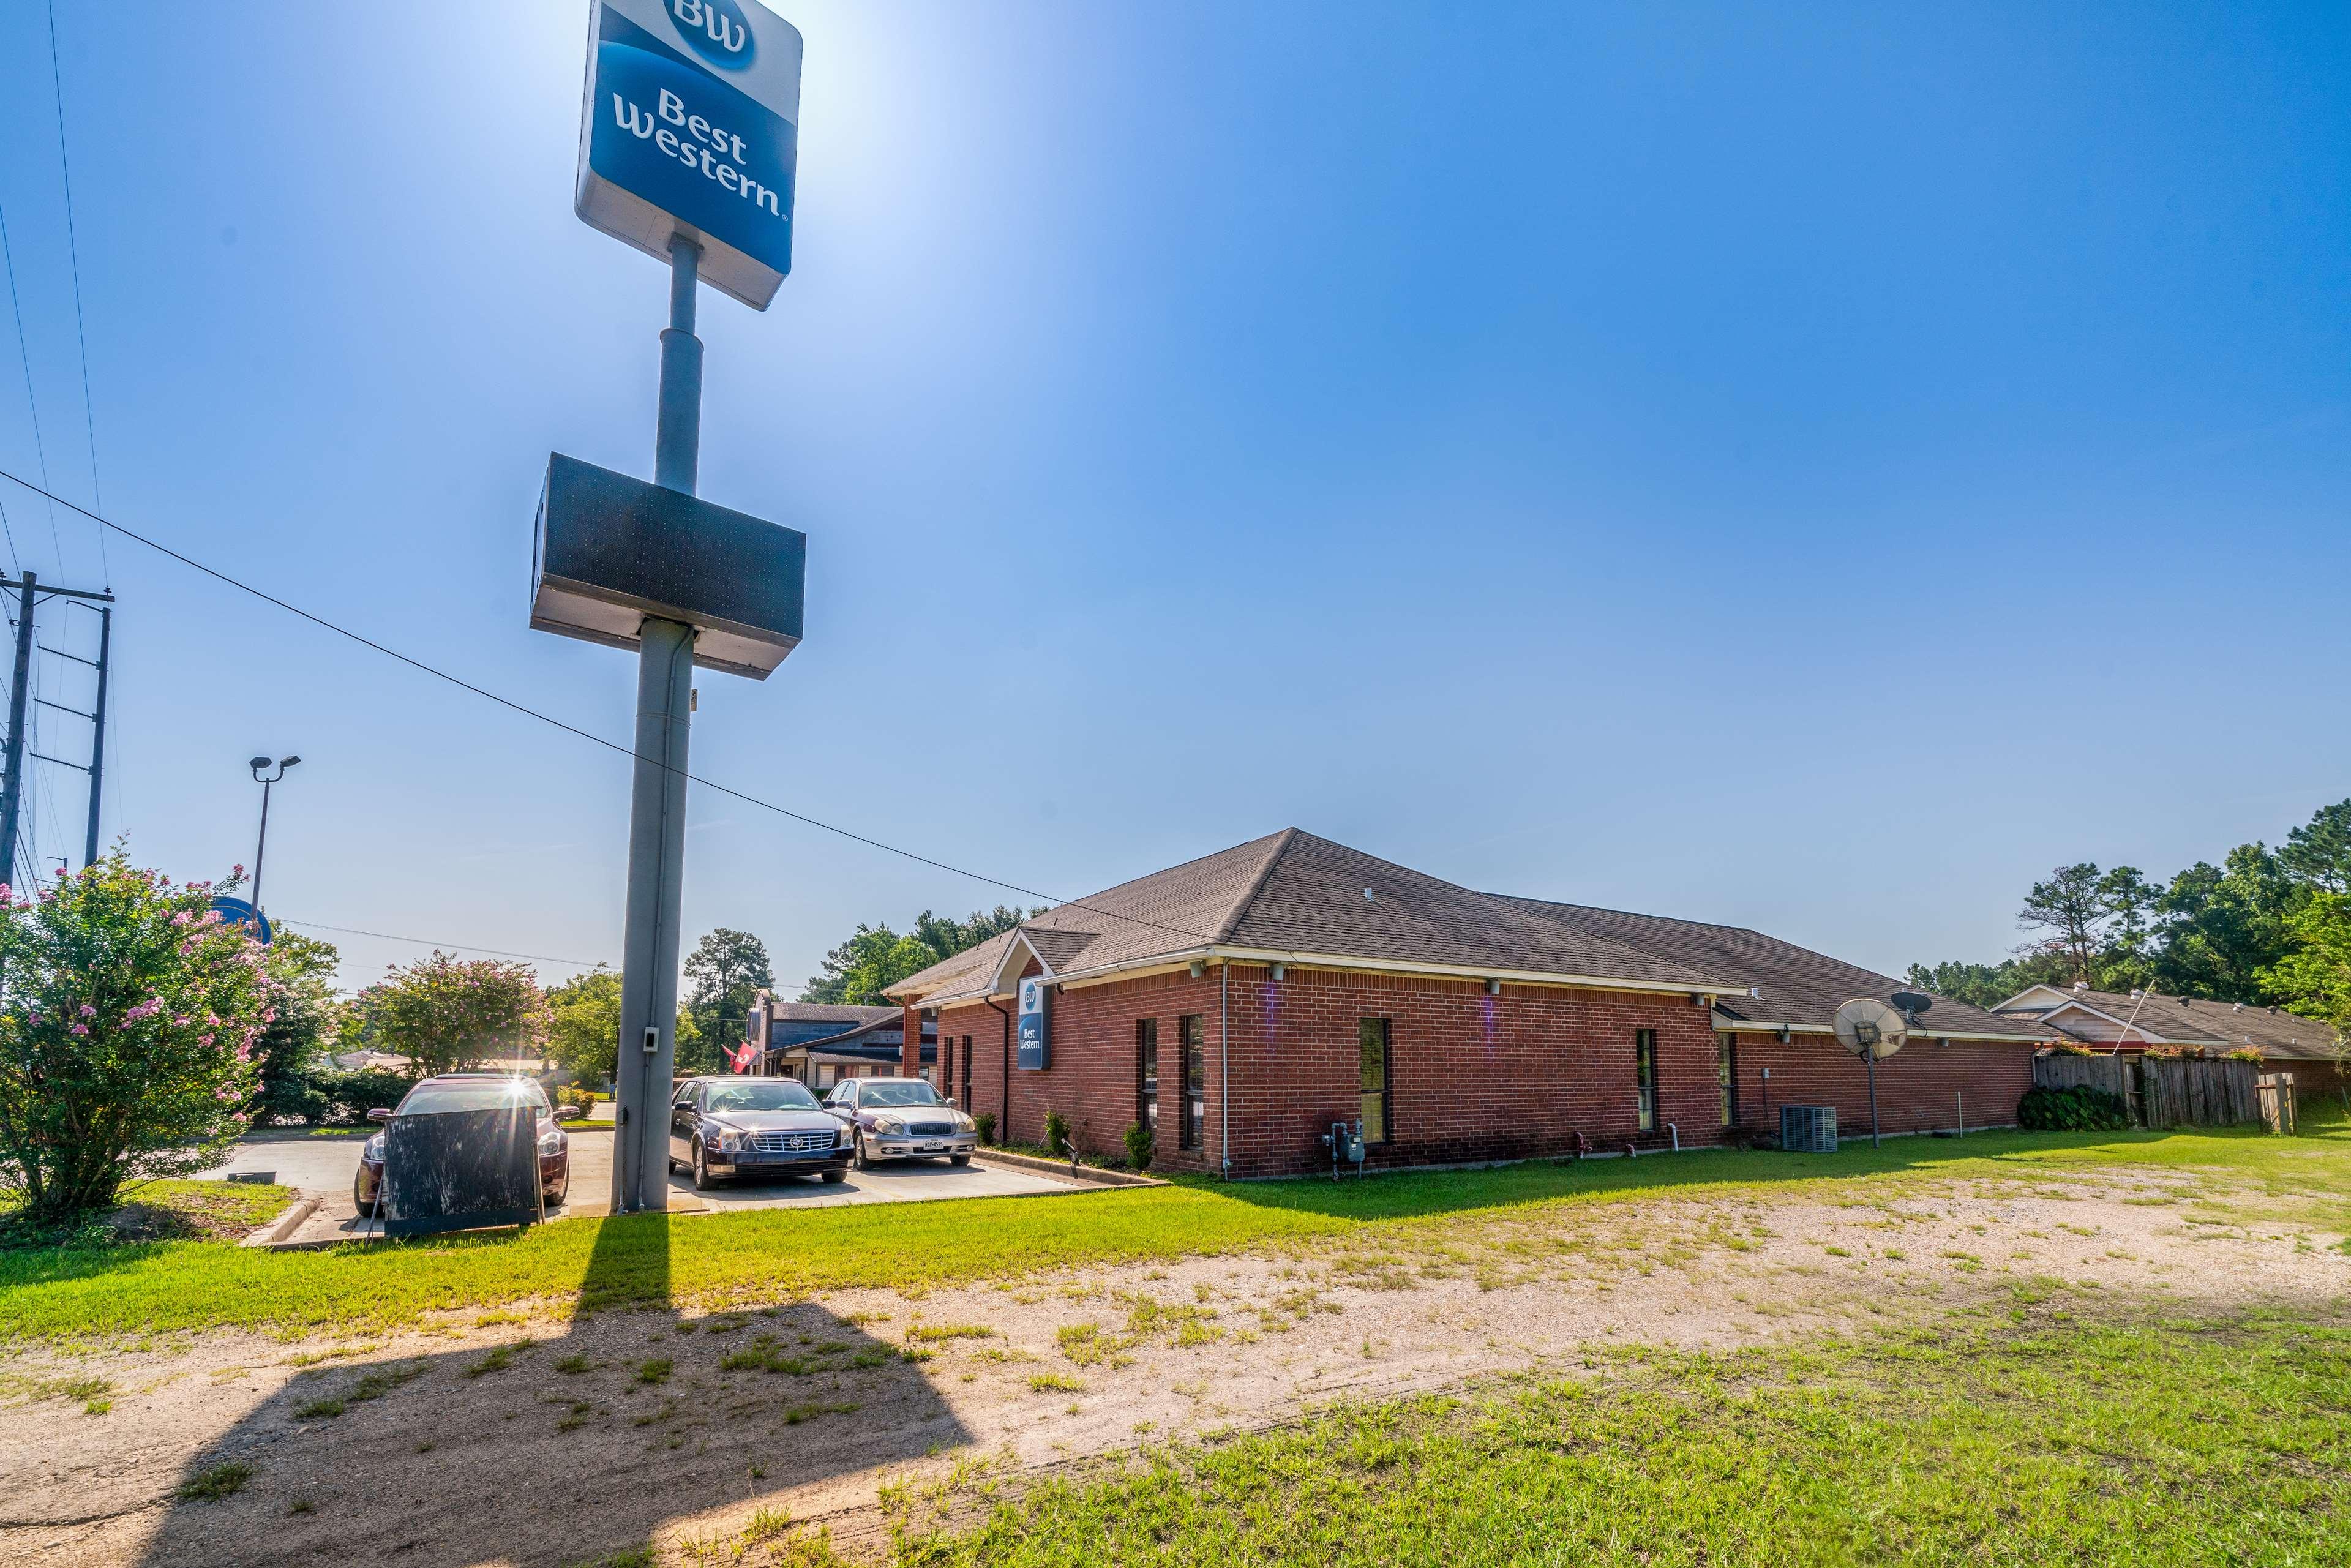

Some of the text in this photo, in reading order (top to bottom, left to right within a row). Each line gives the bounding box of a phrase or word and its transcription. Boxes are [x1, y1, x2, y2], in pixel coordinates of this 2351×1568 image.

[674, 0, 746, 53] BW
[659, 88, 747, 165] Best
[1026, 991, 1035, 1003] BW
[1024, 1028, 1035, 1039] Best
[1020, 1039, 1040, 1049] Western
